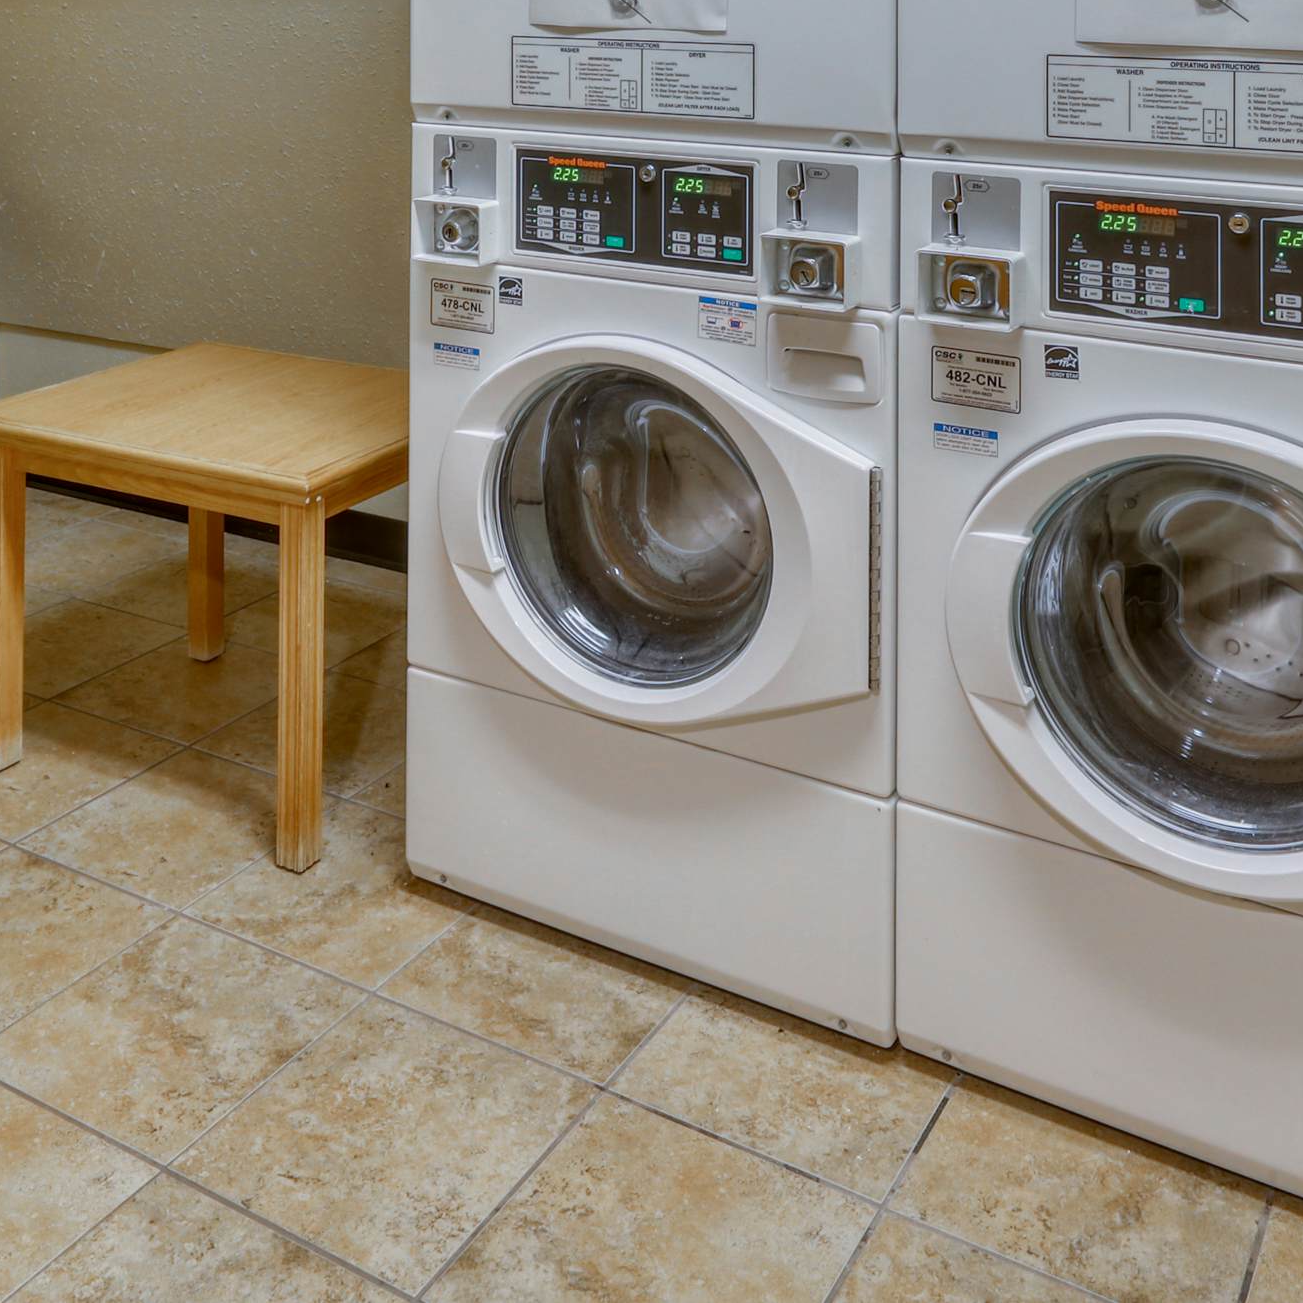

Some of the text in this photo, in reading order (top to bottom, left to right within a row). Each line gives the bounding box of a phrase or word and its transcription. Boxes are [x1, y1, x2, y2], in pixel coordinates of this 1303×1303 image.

[1170, 61, 1261, 72] OPERATING INSTRUCTIONS
[548, 156, 576, 167] Speed
[553, 167, 579, 182] 2.25
[675, 178, 704, 193] 2.25
[1096, 200, 1178, 216] Speed Queen
[1101, 214, 1137, 232] 2.25
[441, 298, 484, 314] 478-CNL
[440, 344, 474, 355] NOTICE
[935, 350, 957, 360] CSC
[946, 369, 1007, 390] 482-CNL
[942, 425, 990, 438] NOTICE
